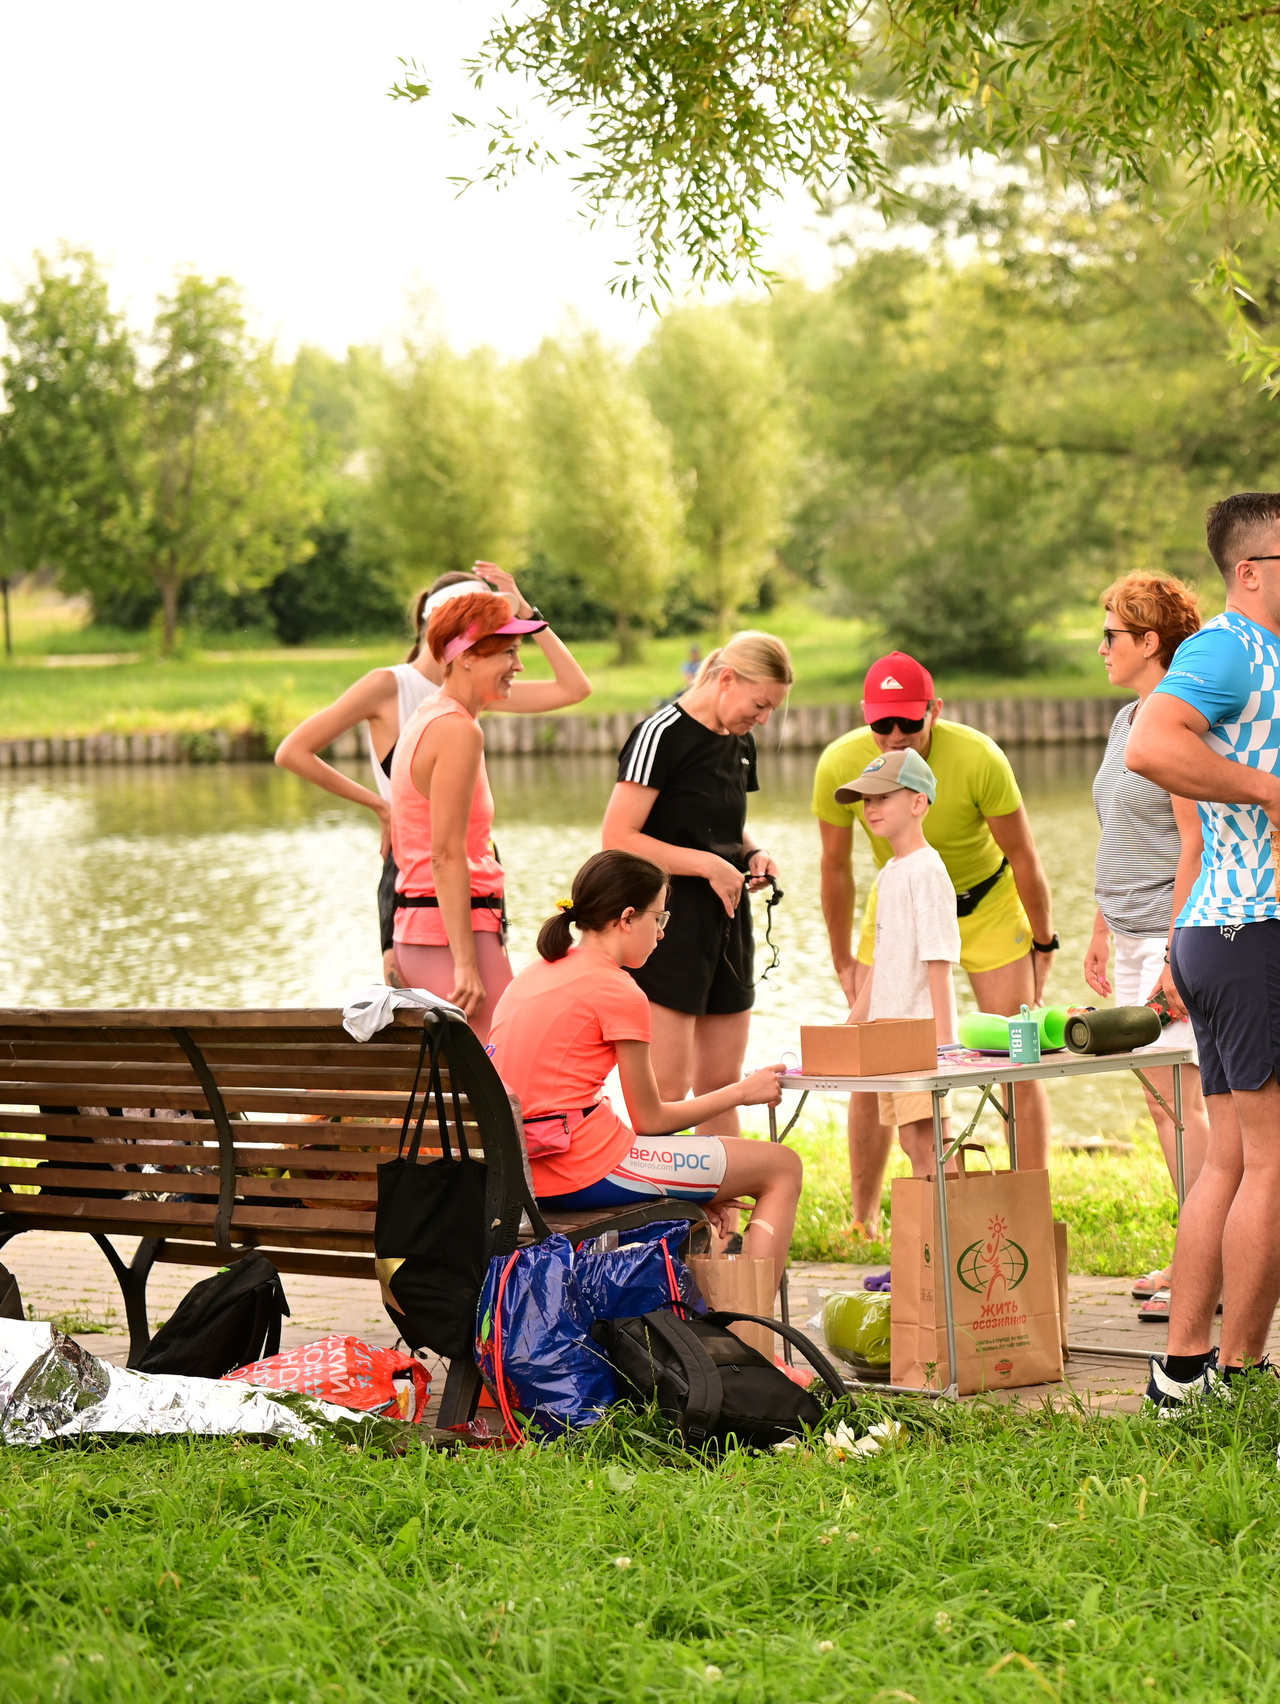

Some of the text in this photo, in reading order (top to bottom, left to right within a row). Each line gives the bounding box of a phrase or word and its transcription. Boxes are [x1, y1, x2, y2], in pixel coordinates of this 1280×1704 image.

[1073, 1028, 1087, 1040] JBL
[1011, 1028, 1023, 1058] JBL
[629, 1147, 711, 1172] велорос
[629, 1160, 673, 1171] veloros.com
[981, 1300, 1019, 1318] ЖИТЬ
[972, 1314, 1027, 1331] ОСОЗНАННО
